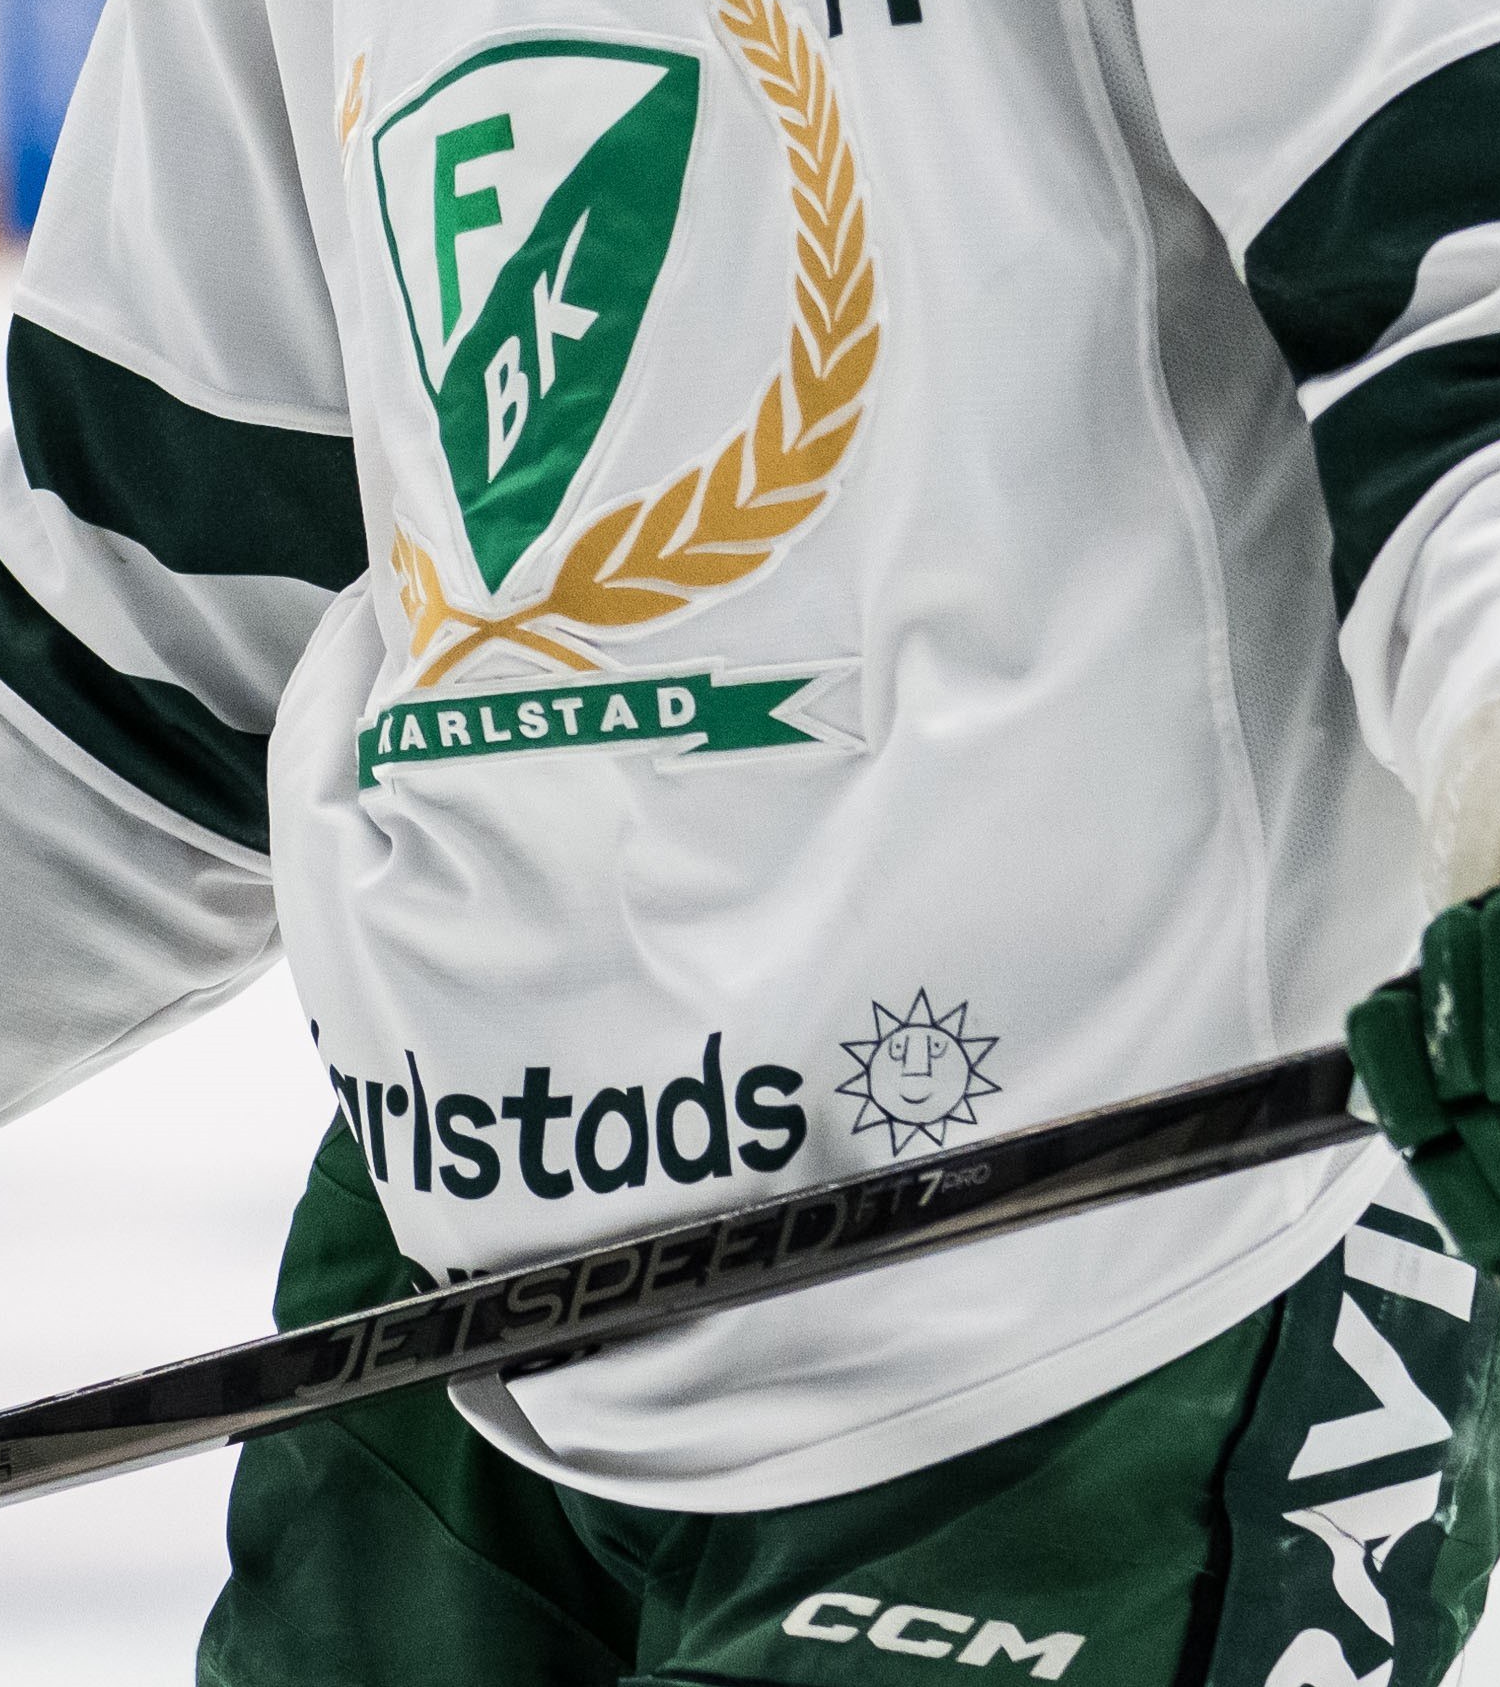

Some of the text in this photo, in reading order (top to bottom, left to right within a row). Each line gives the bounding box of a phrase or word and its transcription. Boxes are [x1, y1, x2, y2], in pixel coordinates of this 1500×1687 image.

[376, 687, 698, 757] KARLSTAD
[311, 1018, 807, 1201] arlstads
[294, 1188, 852, 1400] JETSPEED
[780, 1592, 1086, 1682] CCM
